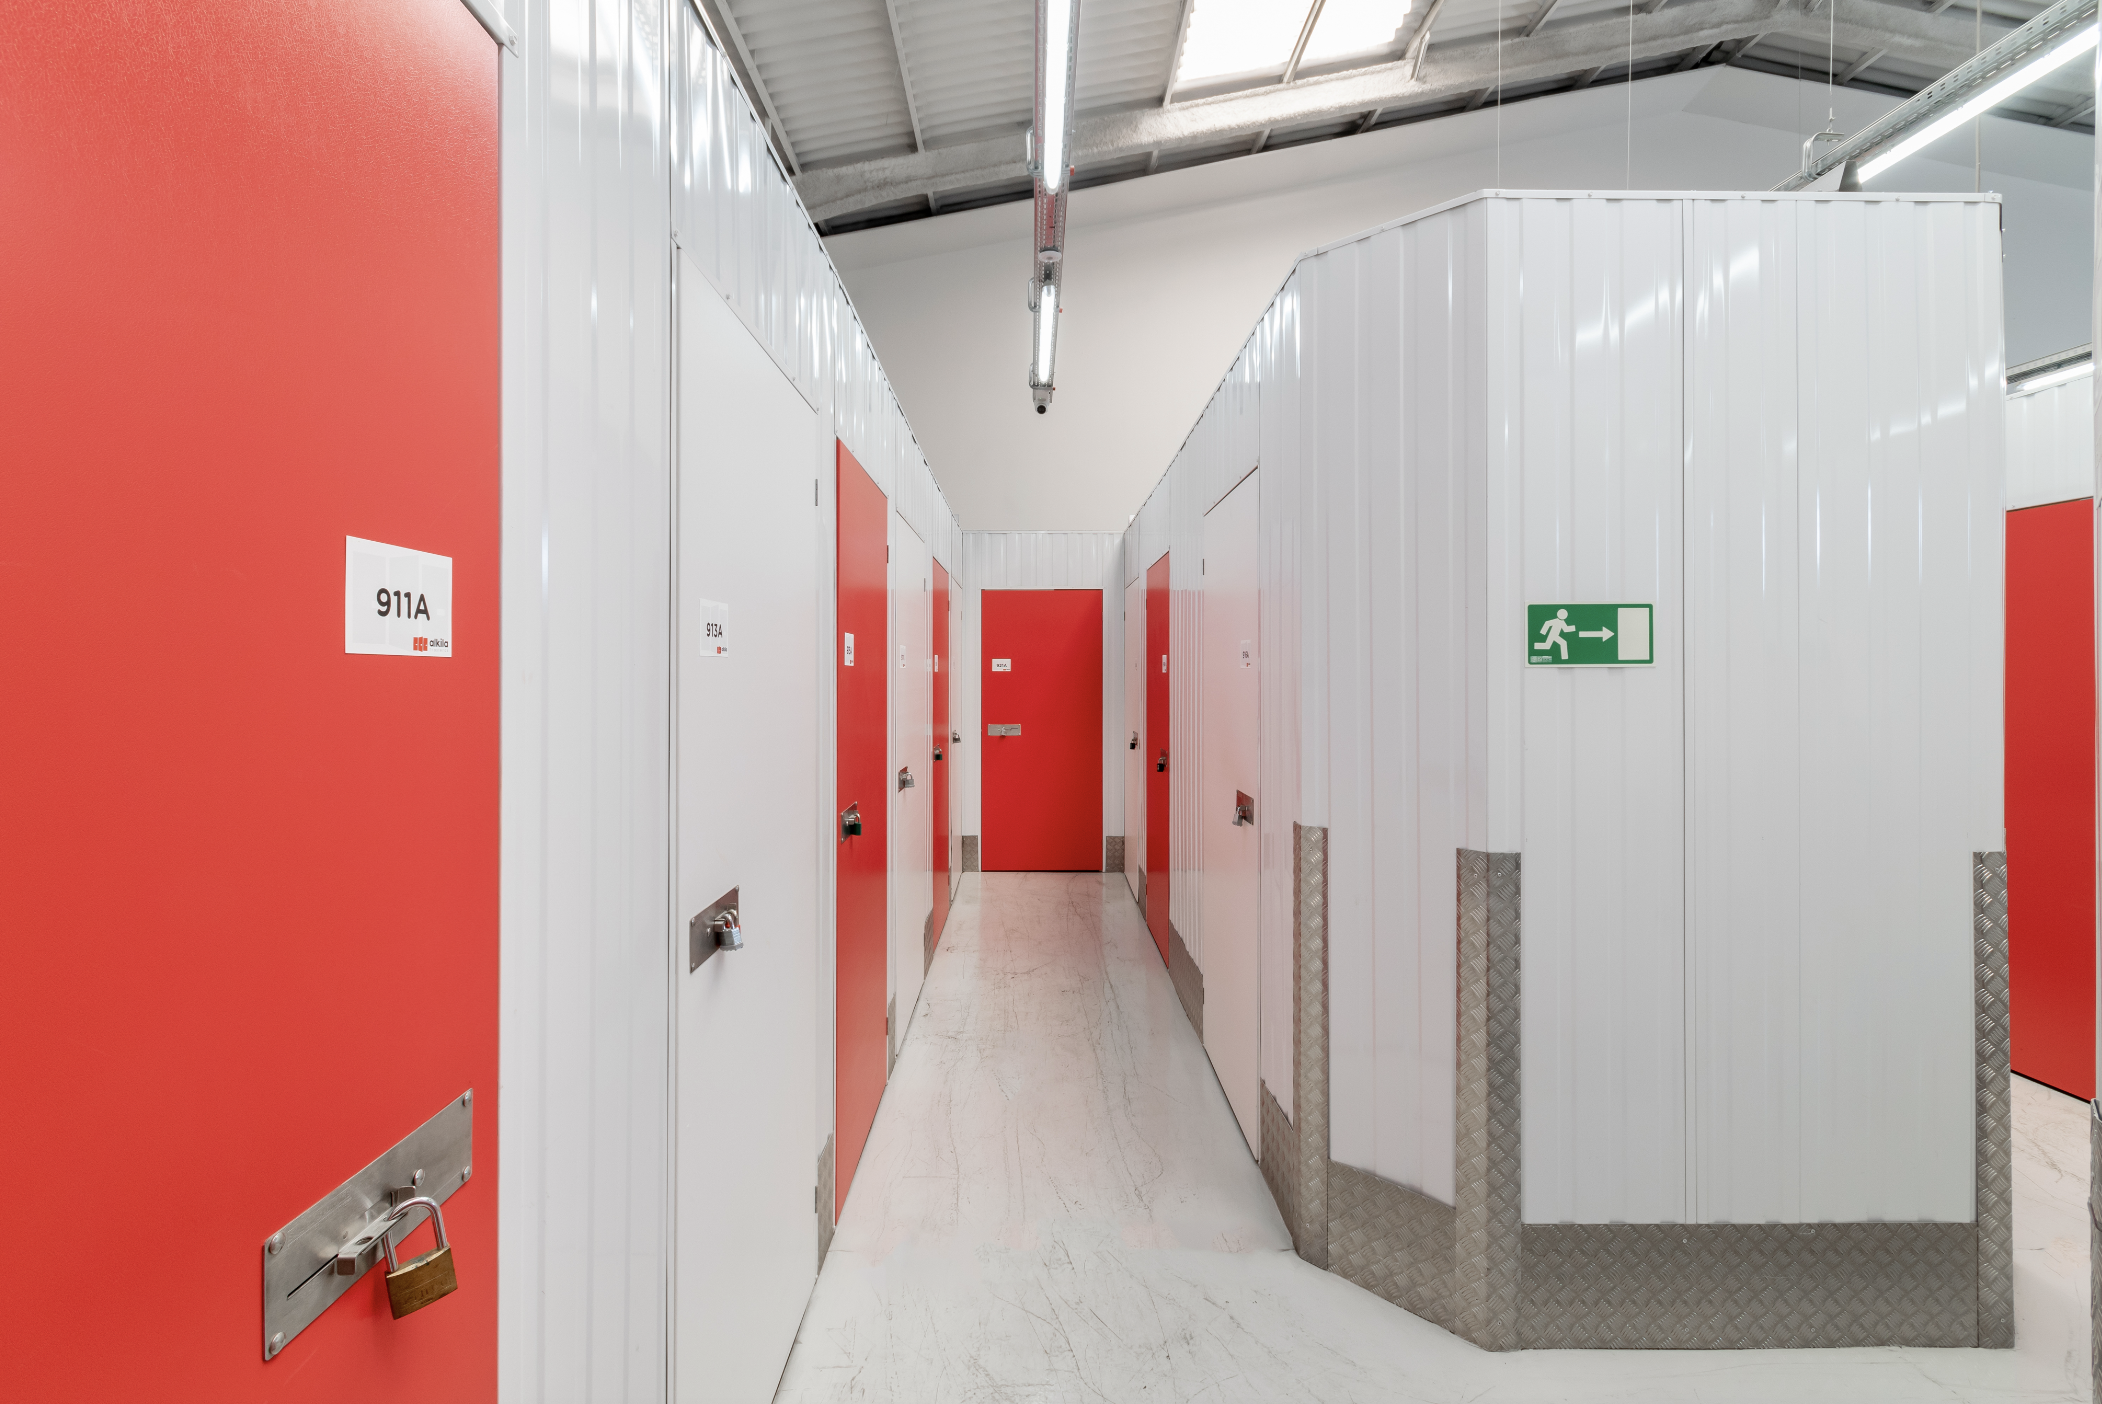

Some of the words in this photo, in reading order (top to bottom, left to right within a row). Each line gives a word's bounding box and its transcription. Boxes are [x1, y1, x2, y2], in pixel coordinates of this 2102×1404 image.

[376, 587, 430, 621] 911A
[706, 622, 722, 638] 913A
[429, 638, 448, 648] alkila
